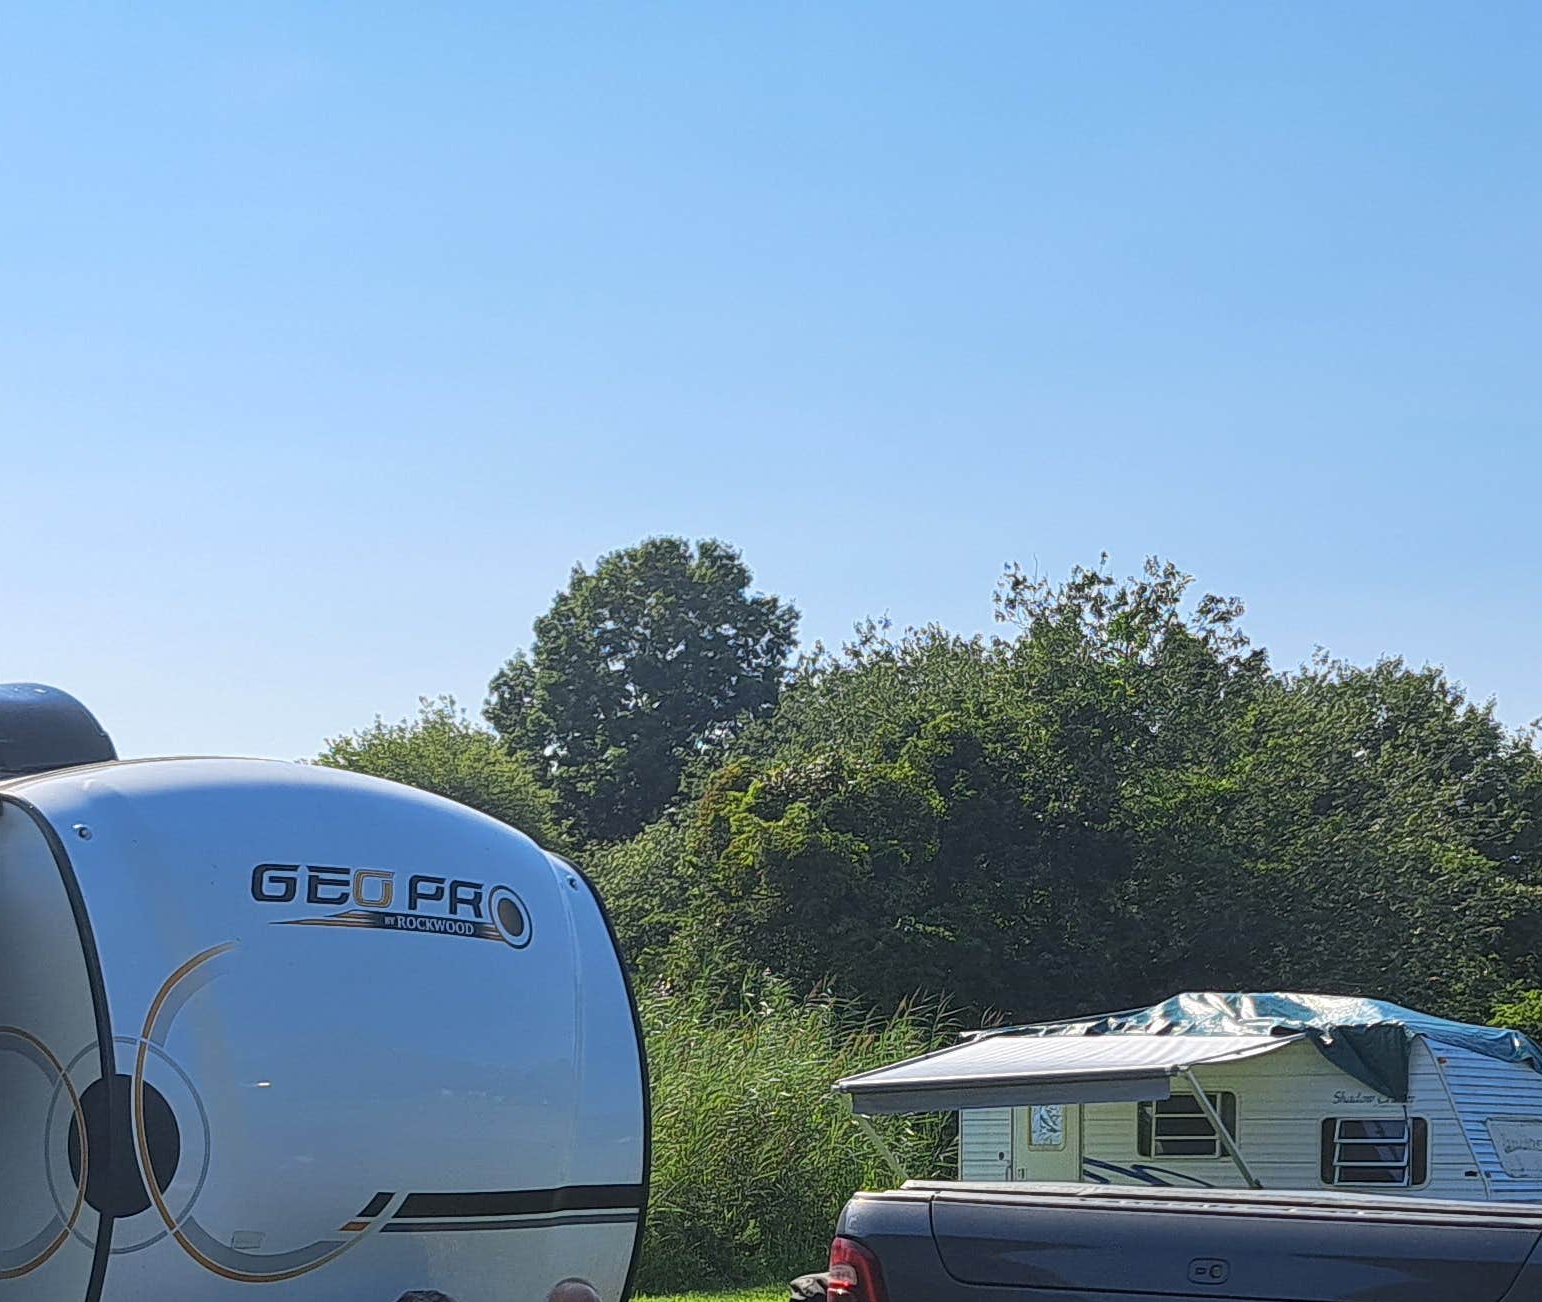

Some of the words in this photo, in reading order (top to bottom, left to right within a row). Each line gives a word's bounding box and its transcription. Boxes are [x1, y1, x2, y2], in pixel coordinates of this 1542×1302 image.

[250, 863, 395, 908] GEO
[407, 875, 533, 950] PRO
[396, 915, 475, 935] ROCKWOOD
